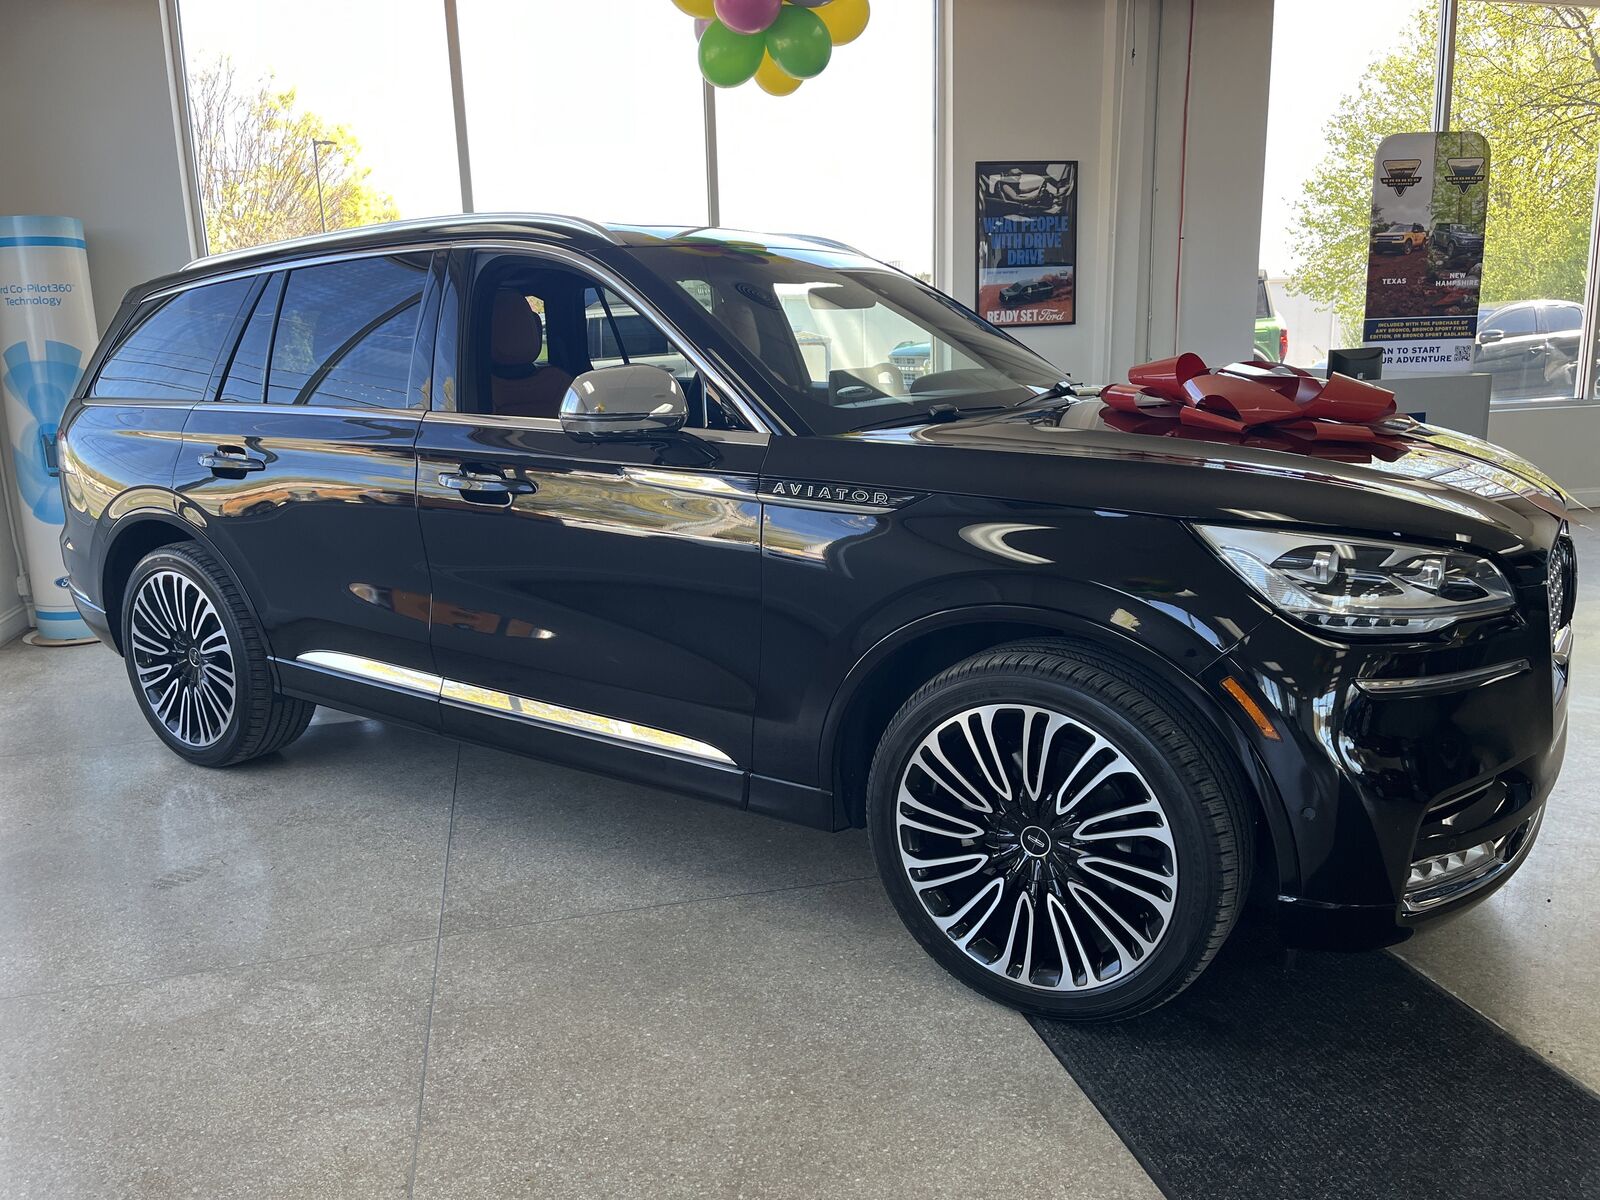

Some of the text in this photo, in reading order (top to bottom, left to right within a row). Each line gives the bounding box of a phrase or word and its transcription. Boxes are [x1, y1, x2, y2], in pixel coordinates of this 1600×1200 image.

[983, 215, 1069, 233] WHAT PEOPLE
[991, 231, 1062, 249] WITH DRIVE
[1008, 248, 1045, 265] DRIVE
[0, 284, 9, 294] rd
[1435, 279, 1480, 287] HAMPSHIRE
[4, 296, 62, 307] Technology
[986, 308, 1065, 323] READY SET Ford
[1411, 346, 1441, 354] START
[1396, 355, 1452, 364] ADVENTURE
[772, 482, 889, 505] AVIATOR
